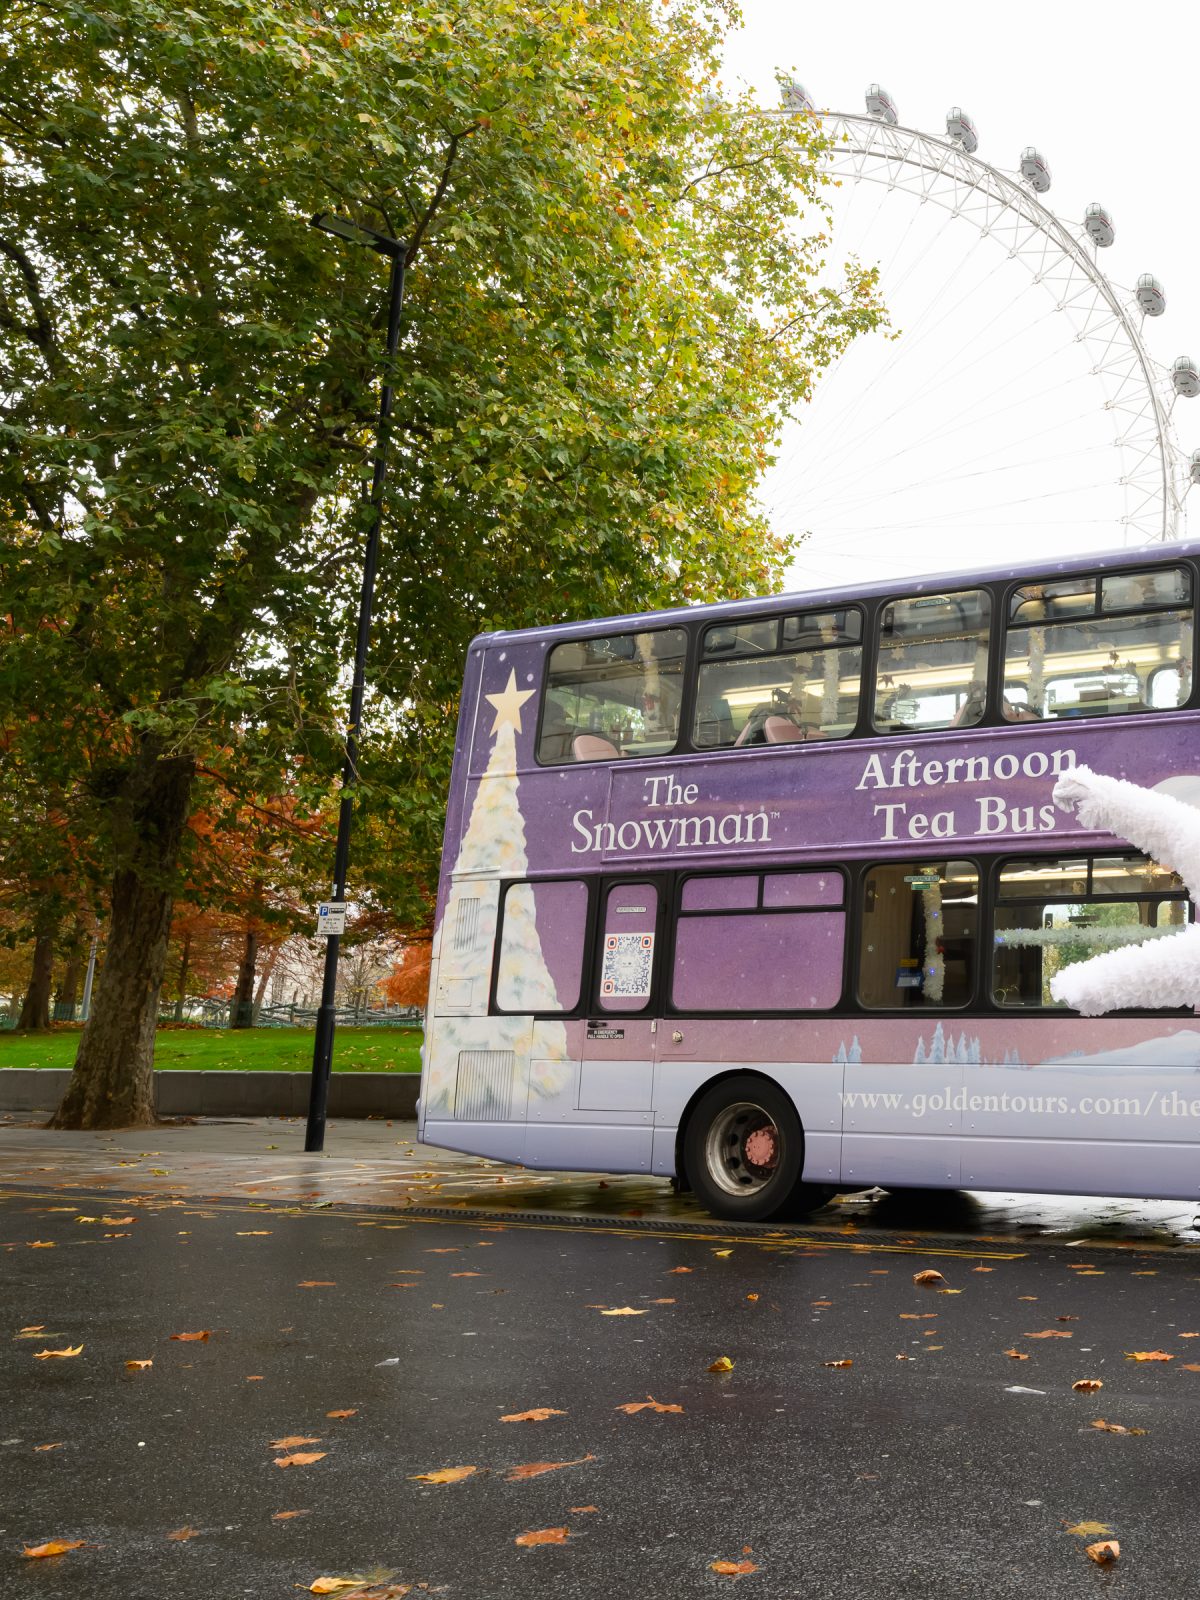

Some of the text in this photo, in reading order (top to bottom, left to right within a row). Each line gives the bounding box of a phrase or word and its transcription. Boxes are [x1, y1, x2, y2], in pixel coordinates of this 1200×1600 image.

[644, 774, 699, 807] The
[854, 749, 1077, 791] Afternoon
[873, 796, 1056, 841] Tea Bus
